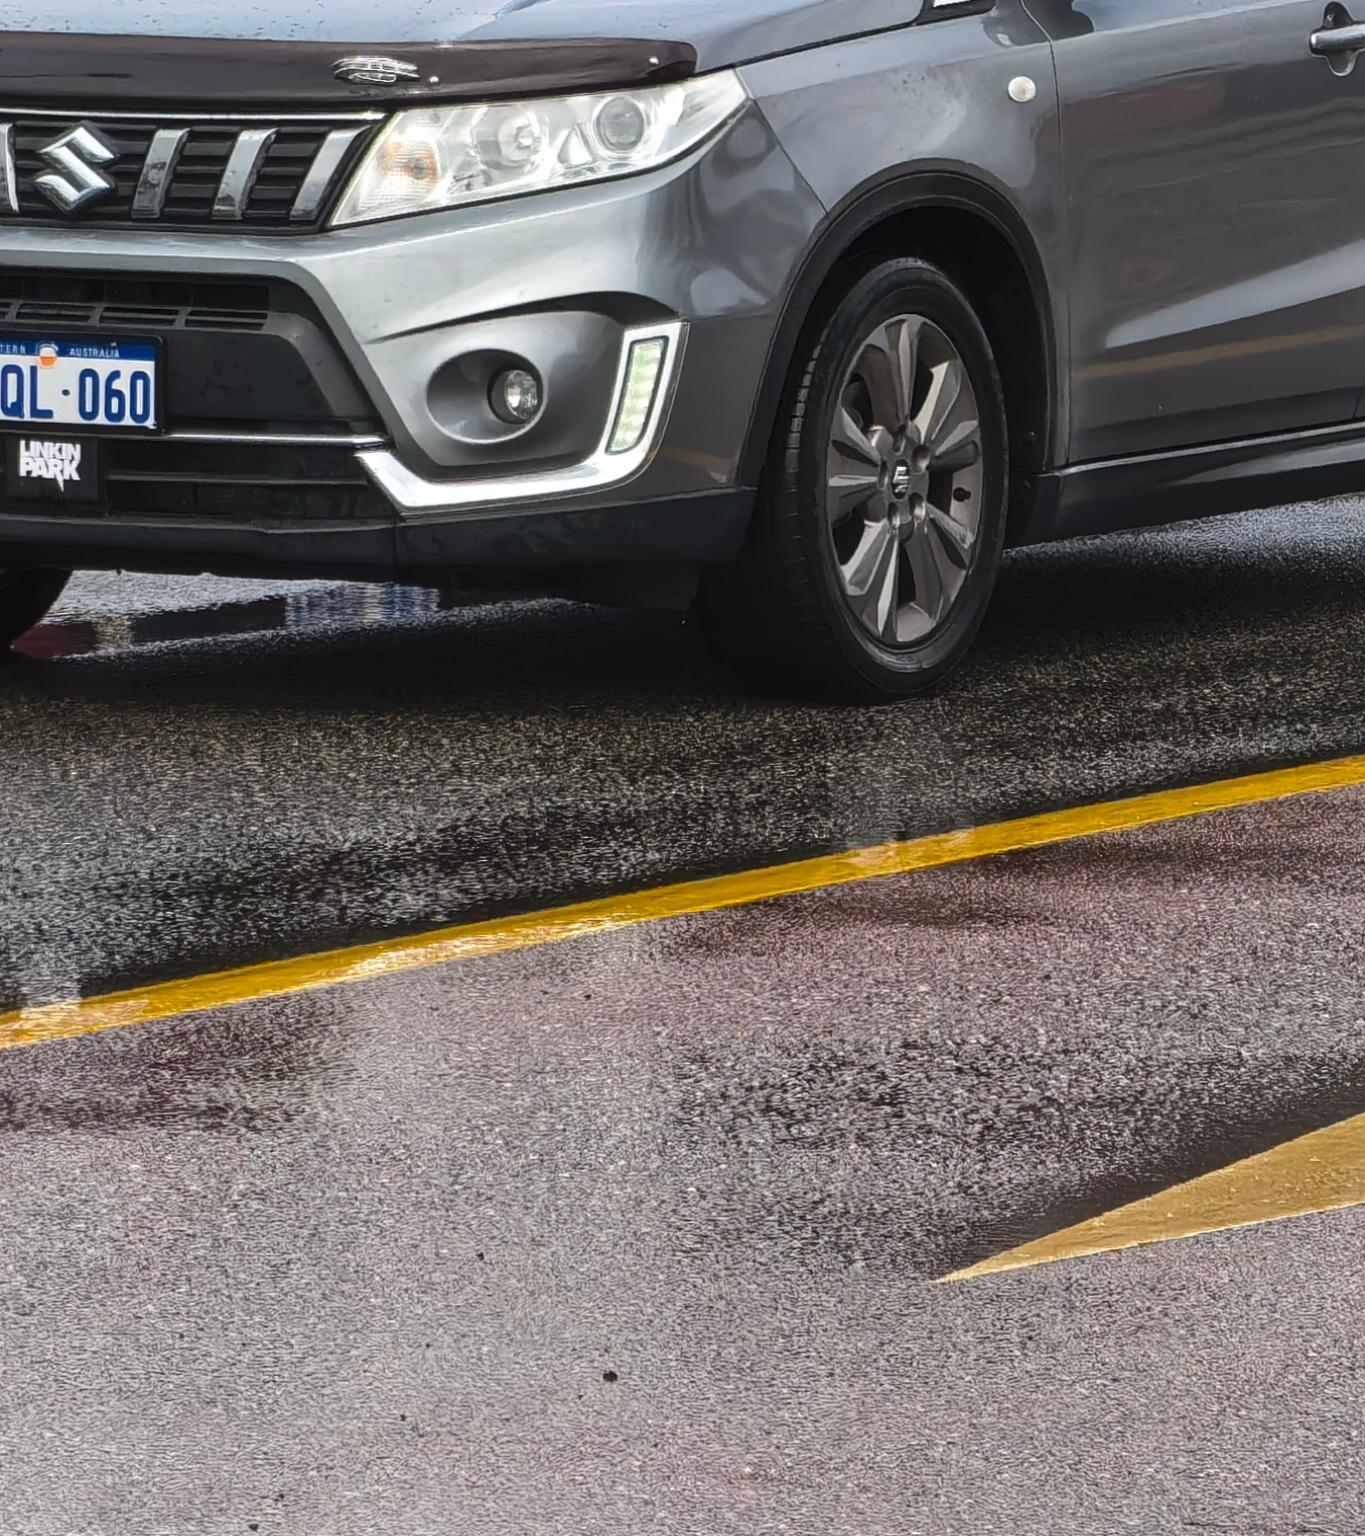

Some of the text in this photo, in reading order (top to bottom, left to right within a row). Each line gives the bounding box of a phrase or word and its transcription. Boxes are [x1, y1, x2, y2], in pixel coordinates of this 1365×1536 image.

[69, 347, 120, 359] AUSTRALIA
[19, 438, 82, 463] LINKIN
[19, 456, 82, 492] PARK
